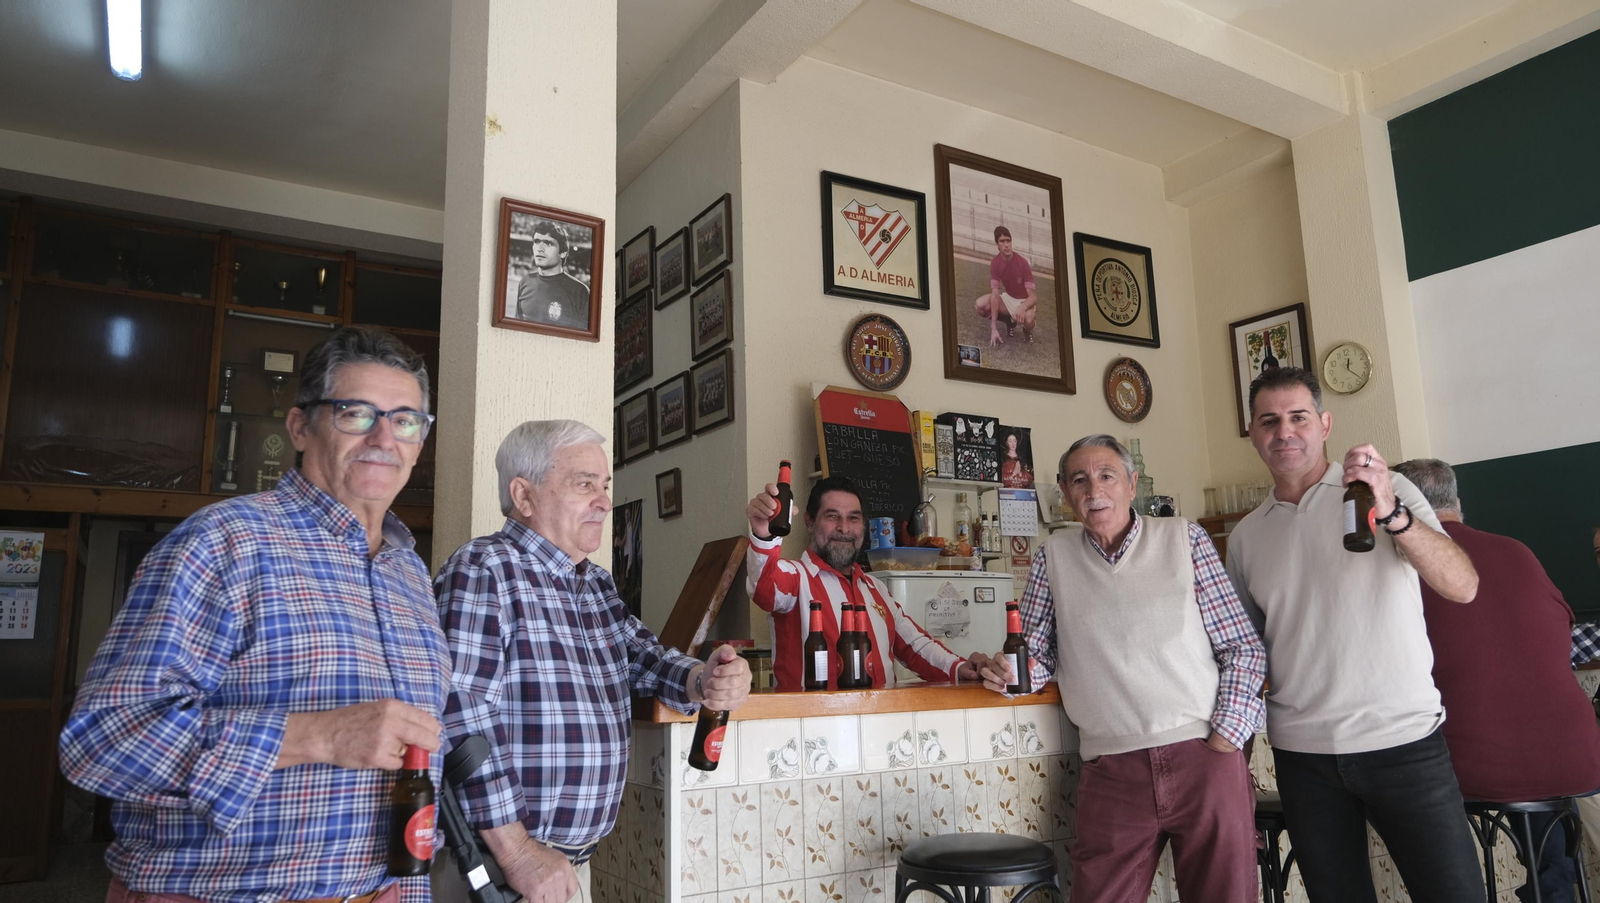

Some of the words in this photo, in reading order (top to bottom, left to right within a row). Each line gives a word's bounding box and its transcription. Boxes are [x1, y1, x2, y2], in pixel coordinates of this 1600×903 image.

[848, 214, 873, 223] ALMERIA
[1096, 263, 1114, 283] DEPORTIVA
[1115, 264, 1133, 283] ANTONIO
[861, 269, 915, 289] ALMERIA
[1110, 312, 1131, 322] ALMERIA
[1359, 353, 1365, 361] 2
[1363, 361, 1368, 369] 3
[1355, 378, 1361, 386] 5
[853, 407, 877, 418] Estrella
[824, 424, 879, 441] CABALLA
[863, 451, 901, 467] QUESO
[7, 563, 38, 574] 2023
